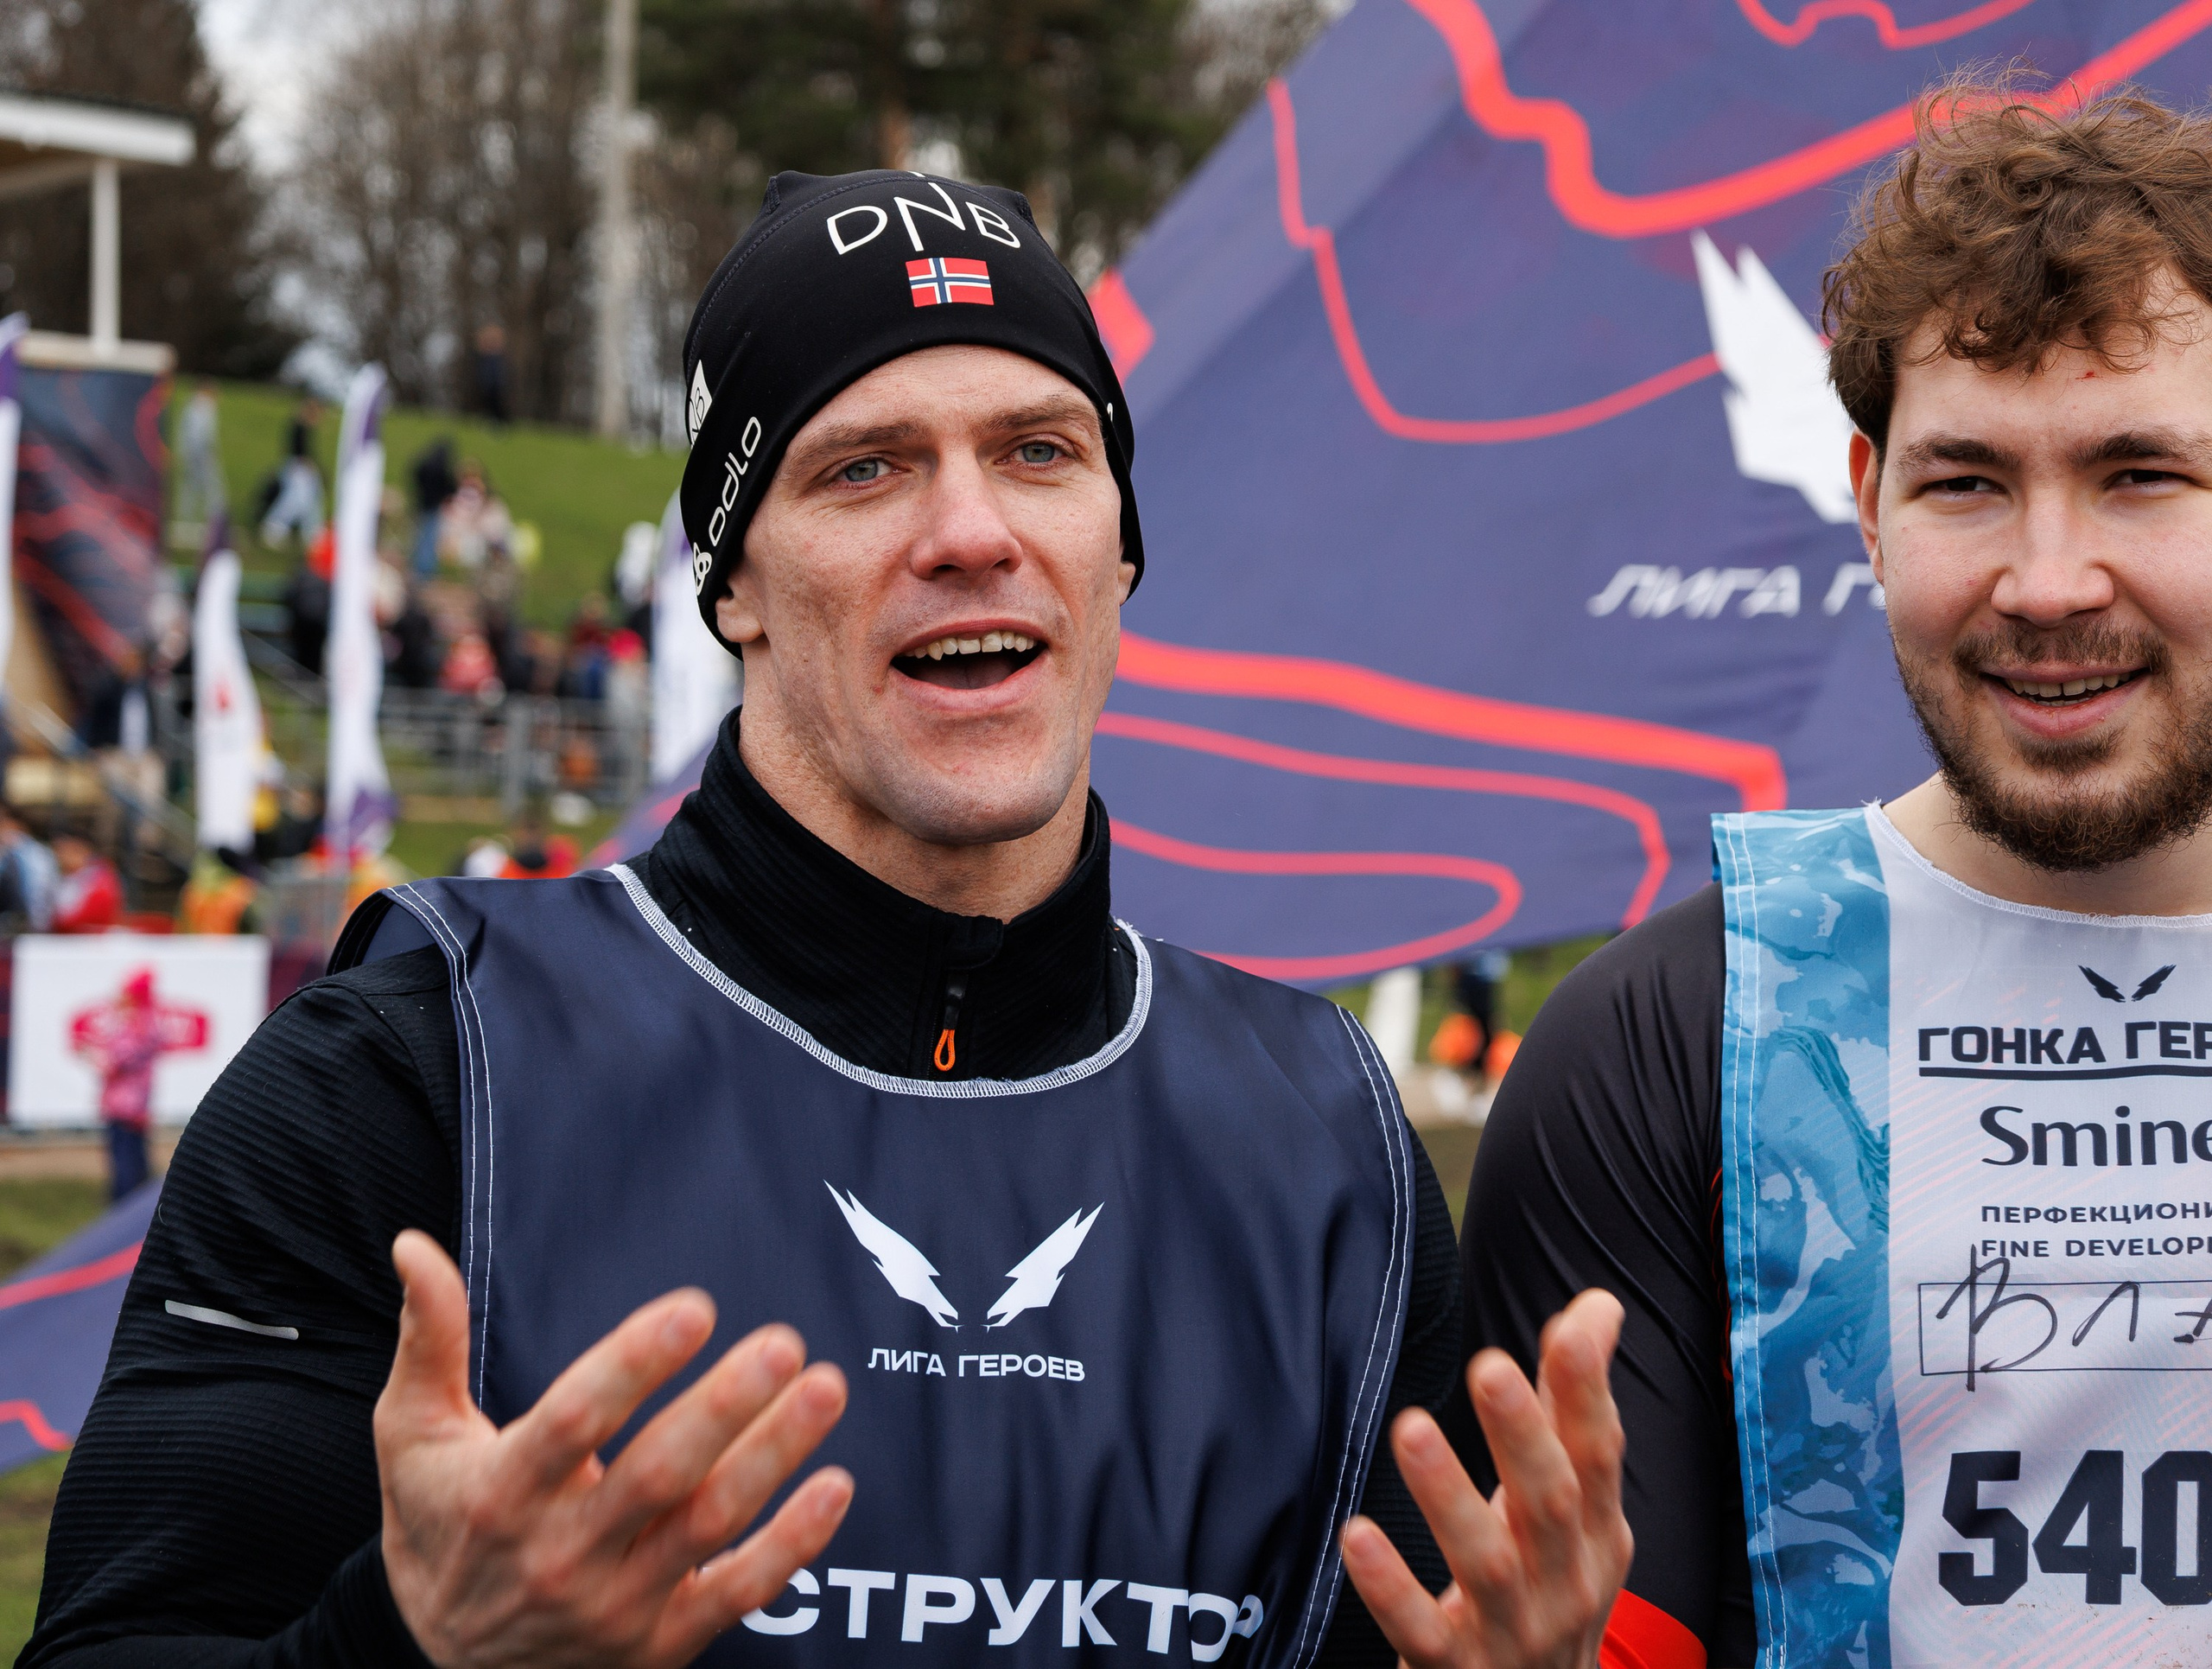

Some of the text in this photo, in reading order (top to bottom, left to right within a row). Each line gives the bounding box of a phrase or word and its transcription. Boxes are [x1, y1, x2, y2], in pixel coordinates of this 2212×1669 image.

[827, 172, 1020, 255] DNB
[1587, 564, 1802, 619] ЛИГА
[1918, 1026, 2106, 1064] ГОНКА
[1981, 1236, 2212, 1258] FINE DEVELOP
[868, 1347, 1085, 1381] ЛИГА ГЕРОЕВ
[1938, 1449, 2212, 1606] 540
